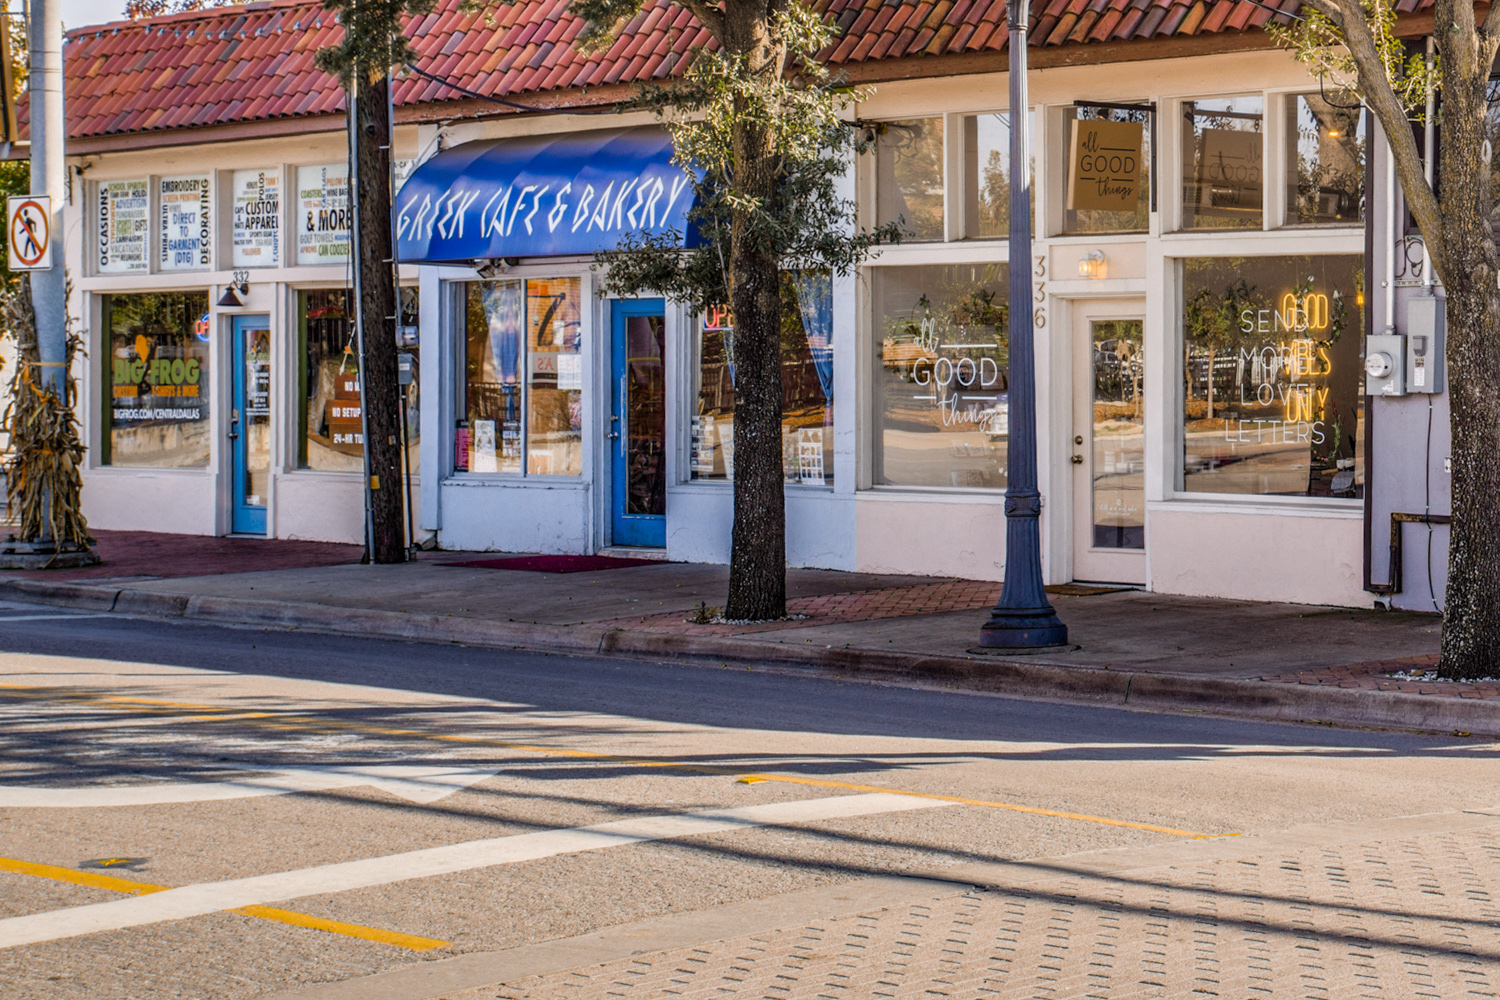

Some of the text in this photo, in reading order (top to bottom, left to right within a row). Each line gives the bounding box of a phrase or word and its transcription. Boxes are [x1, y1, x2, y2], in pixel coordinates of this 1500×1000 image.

[1081, 131, 1100, 153] all
[1080, 154, 1136, 174] GOOD
[162, 180, 200, 192] EMBROIDERY
[1095, 176, 1134, 200] things
[301, 189, 322, 199] COASTERS
[246, 201, 279, 215] CUSTOM
[396, 188, 480, 242] GREEK
[480, 184, 549, 239] CAFE
[571, 175, 690, 233] BAKERY
[173, 213, 196, 225] DIRECT
[201, 178, 209, 264] DECORATING
[245, 216, 279, 230] APPAREL
[307, 211, 315, 232] &
[180, 226, 189, 237] TO
[300, 233, 334, 244] GOLF TOWELS
[110, 243, 142, 254] VACATIONS
[169, 238, 200, 250] GARMENT
[318, 244, 329, 256] CAN
[175, 251, 193, 266] (DTG)
[233, 271, 249, 283] 332
[1034, 255, 1046, 329] 336
[1240, 309, 1309, 333] SEND
[913, 317, 939, 353] all
[1240, 346, 1309, 370] MORE
[114, 359, 199, 385] BIG FROG
[913, 357, 998, 386] GOOD
[345, 381, 353, 392] NO
[1240, 382, 1309, 407] LOVE
[114, 408, 199, 420] BIGFROG.COM/CENTRALDALLAS
[332, 407, 361, 418] NO SETUP
[936, 392, 999, 432] things
[334, 434, 353, 444] 24-HR
[1225, 419, 1326, 445] LETTERS
